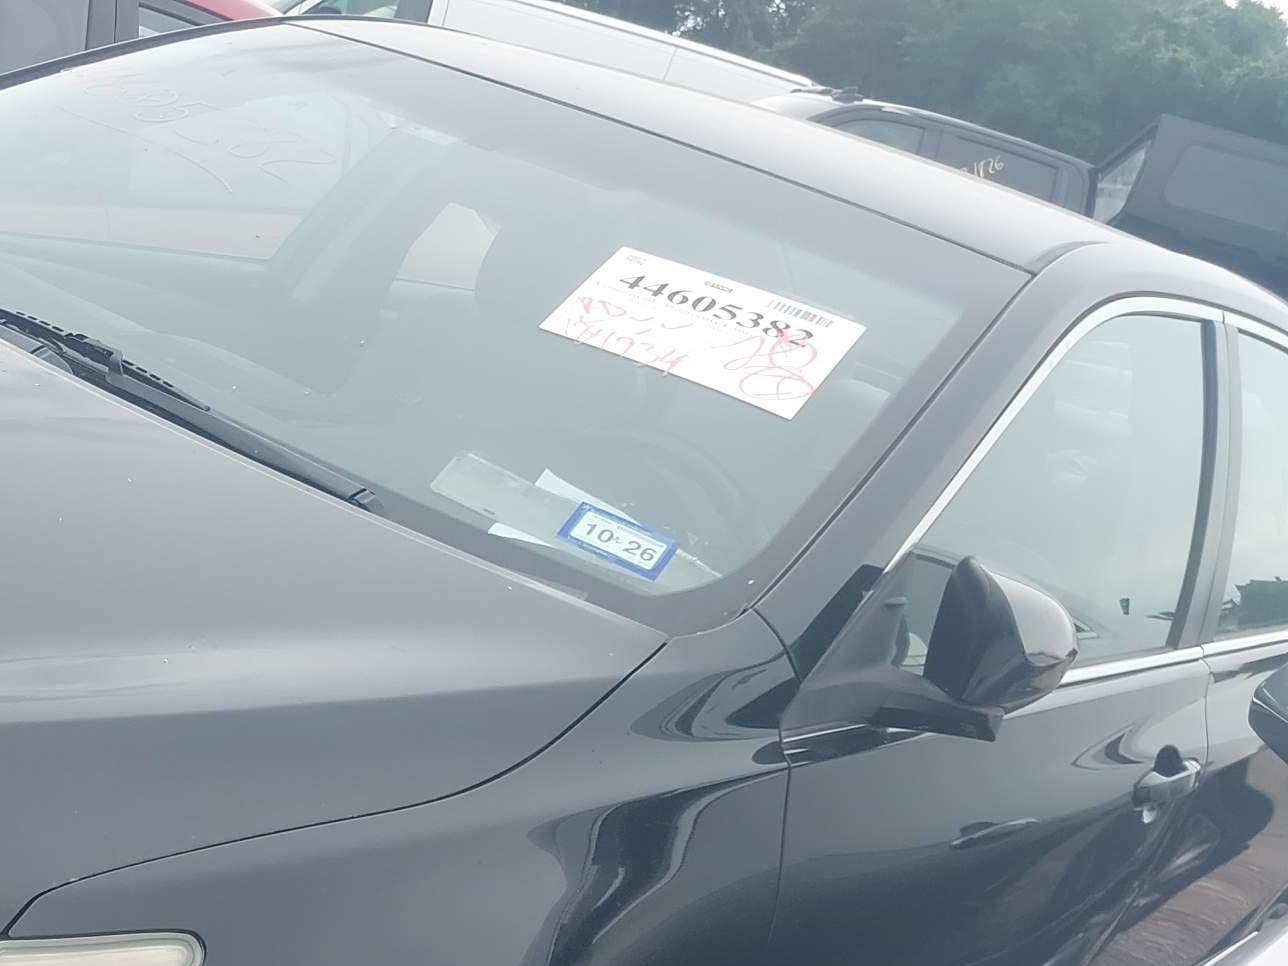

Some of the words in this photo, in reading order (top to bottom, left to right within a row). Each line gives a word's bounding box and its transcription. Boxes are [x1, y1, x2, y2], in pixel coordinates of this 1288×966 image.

[619, 274, 814, 347] 44605382
[585, 523, 614, 544] 10
[623, 540, 657, 562] 26
